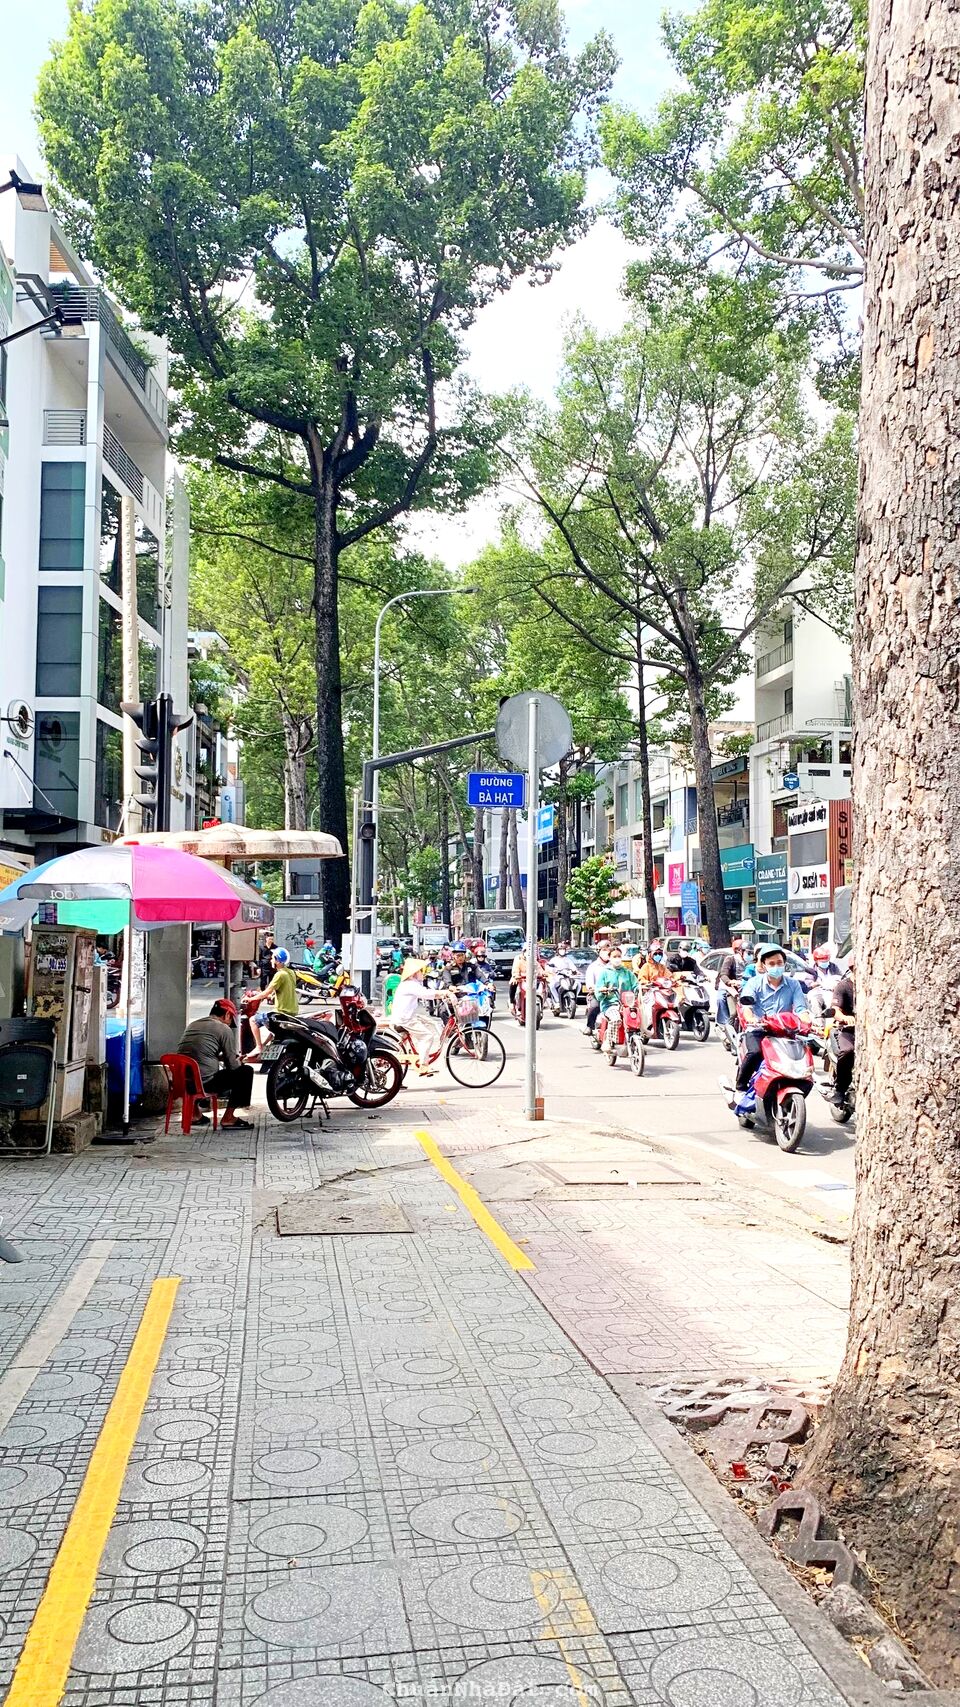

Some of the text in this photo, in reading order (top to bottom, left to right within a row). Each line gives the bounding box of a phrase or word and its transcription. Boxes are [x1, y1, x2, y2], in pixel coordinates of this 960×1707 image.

[480, 776, 513, 787] ĐƯỜNG
[479, 789, 514, 805] BÀ HẠT
